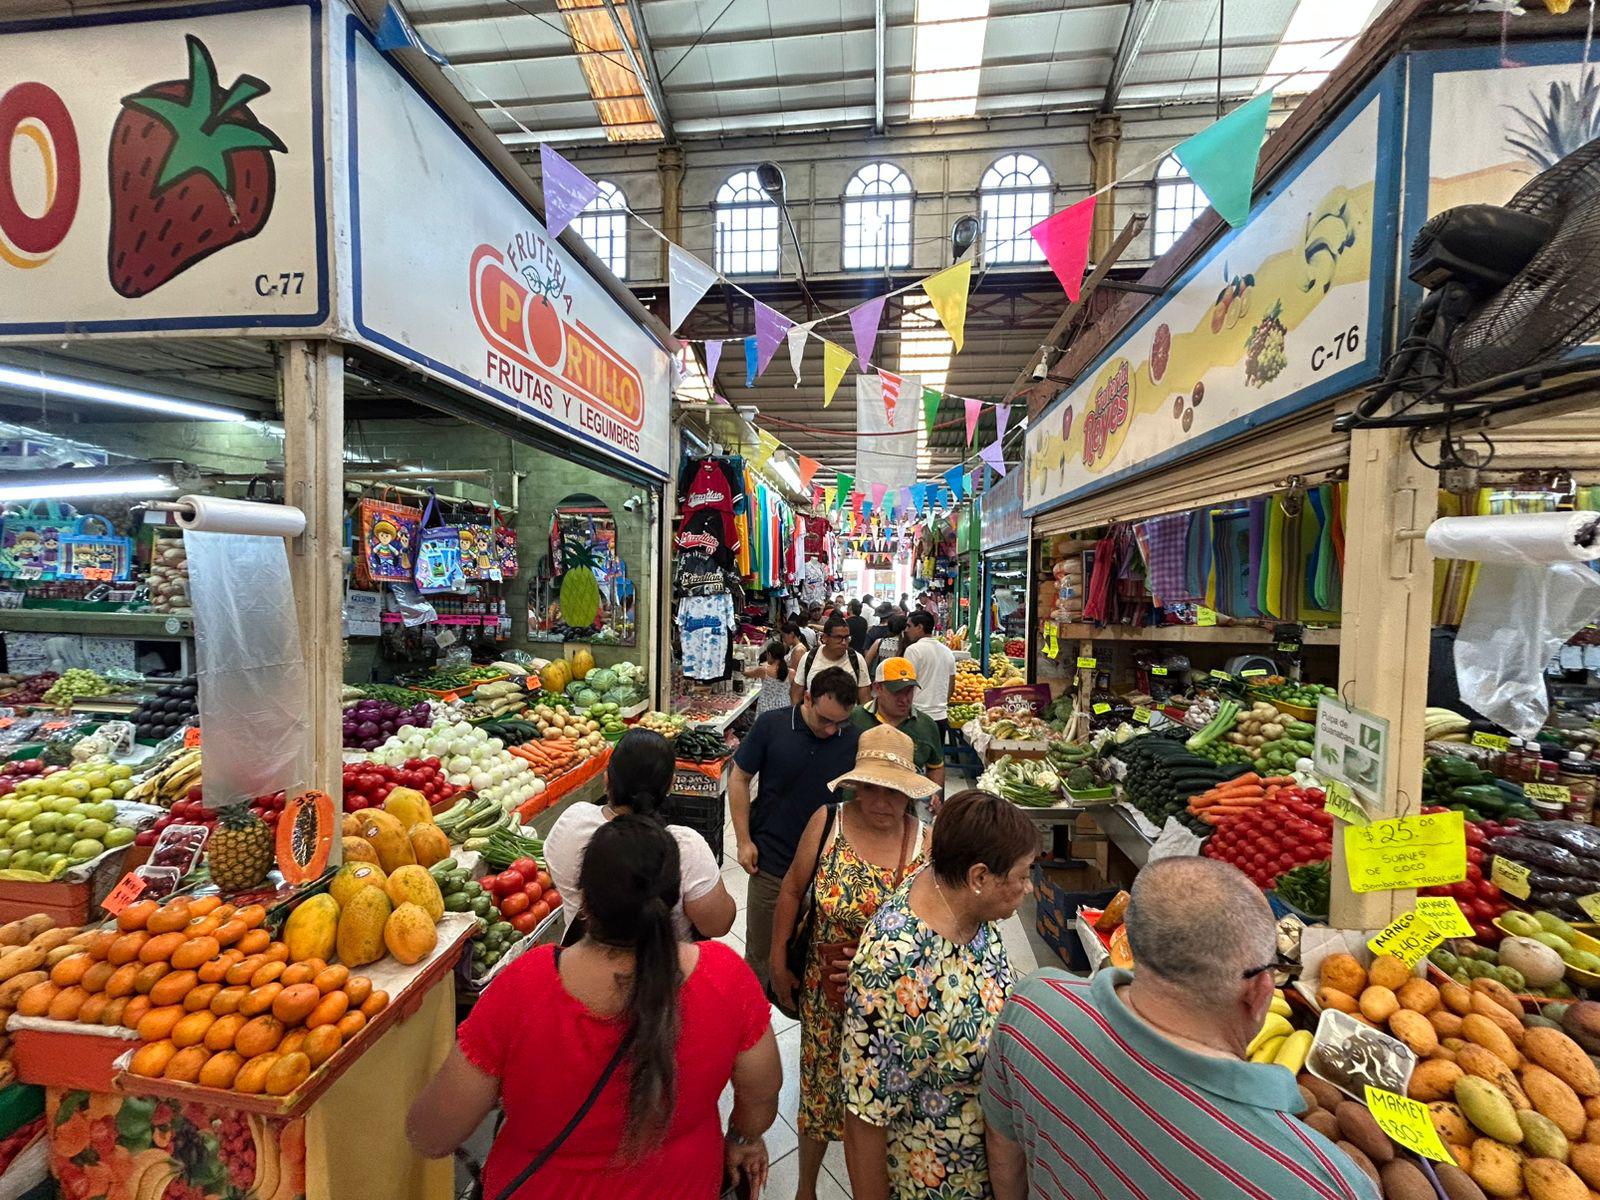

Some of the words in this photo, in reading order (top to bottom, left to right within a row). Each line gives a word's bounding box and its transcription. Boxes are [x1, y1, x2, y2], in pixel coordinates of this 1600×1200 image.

[255, 272, 305, 297] C-77
[506, 230, 573, 315] FRUTERIA
[499, 281, 636, 417] PORTILLO
[1311, 325, 1359, 372] C-76
[486, 350, 553, 410] FRUTAS
[562, 393, 572, 418] Y
[579, 404, 640, 453] LEGUMBRES
[1321, 710, 1338, 726] Pulpa
[1339, 718, 1349, 729] de
[1393, 862, 1426, 874] COCO
[1375, 914, 1415, 948] MANGO
[1371, 1089, 1427, 1125] MAMEY
